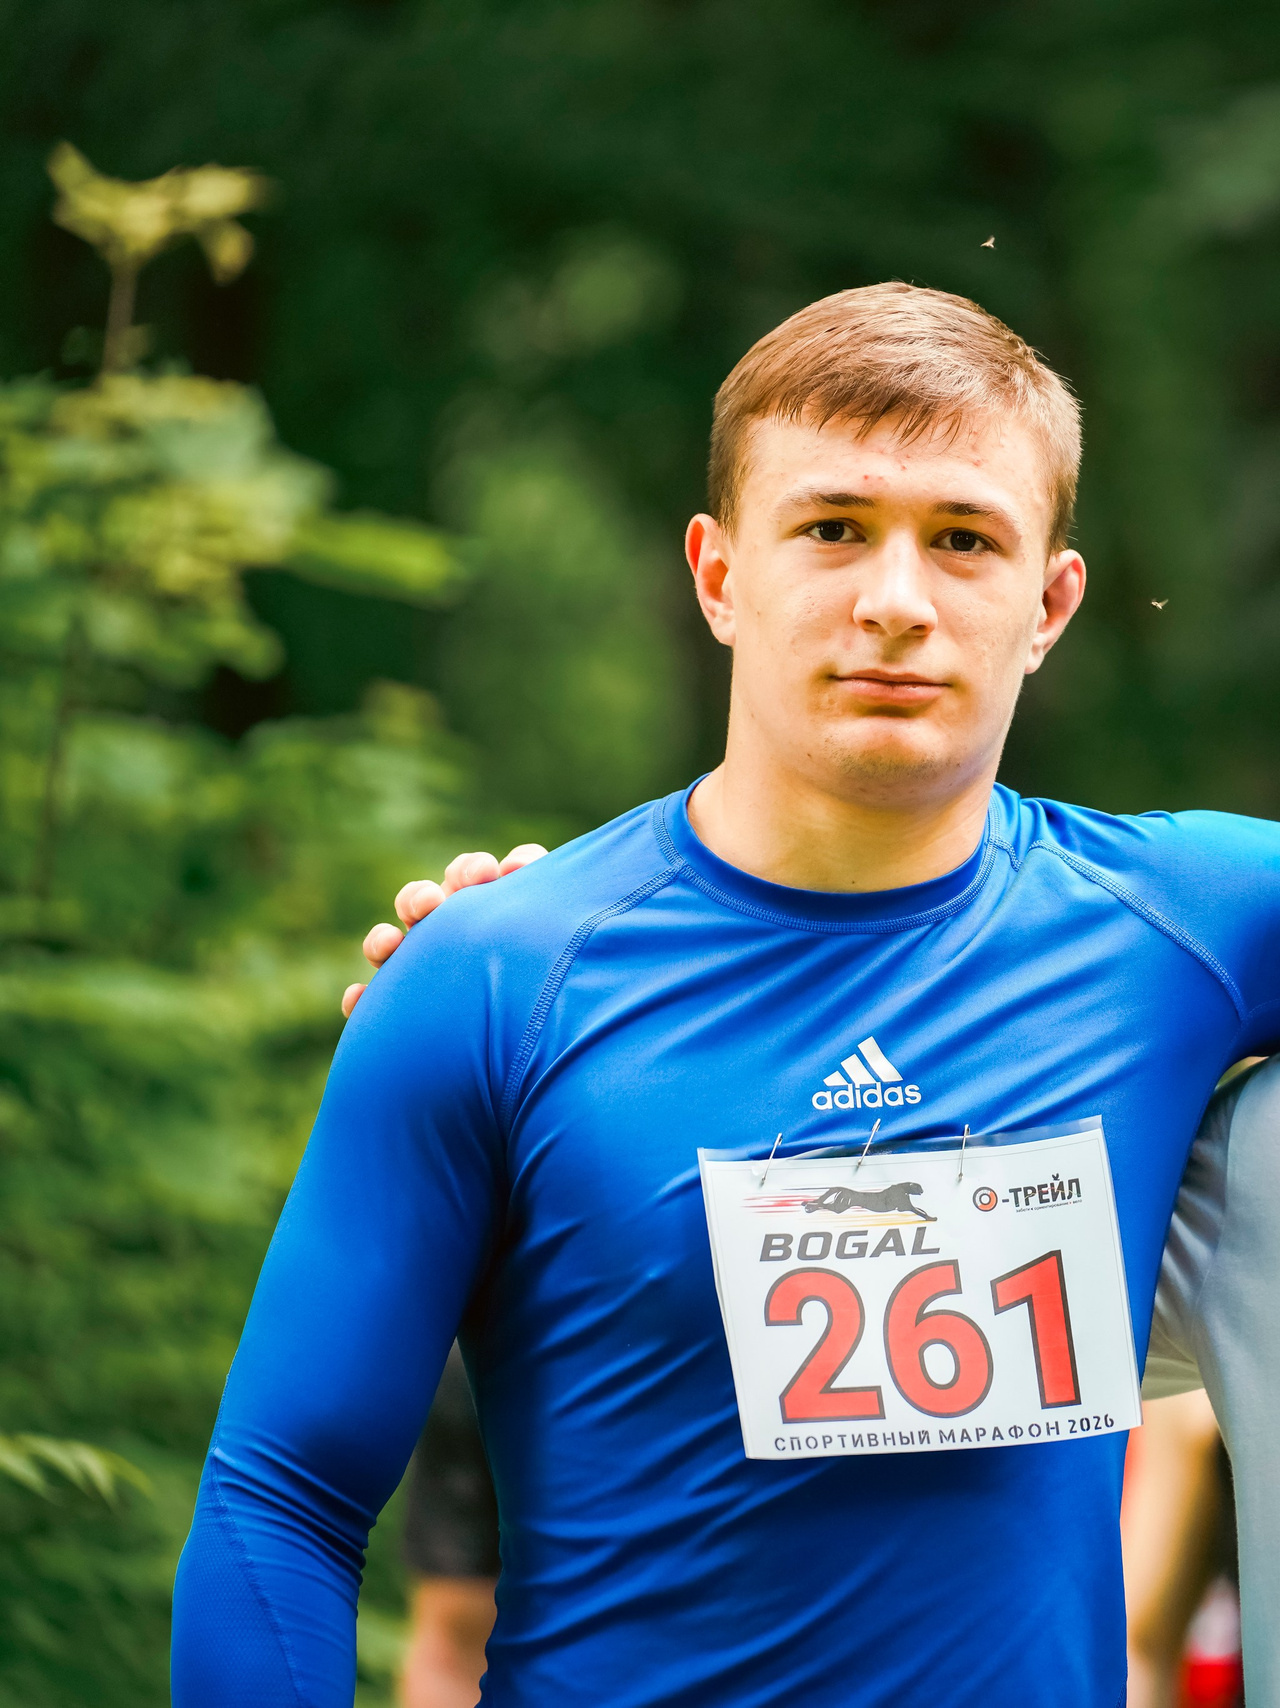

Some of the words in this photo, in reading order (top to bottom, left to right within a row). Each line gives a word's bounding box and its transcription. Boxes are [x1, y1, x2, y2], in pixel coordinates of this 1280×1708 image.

[812, 1083, 922, 1110] adidas
[759, 1226, 940, 1262] BOGAL
[764, 1249, 1082, 1424] 261
[774, 1430, 931, 1451] СПОРТИВНЫЙ
[938, 1421, 1060, 1444] МАРАФОН
[1068, 1414, 1115, 1434] 2026
